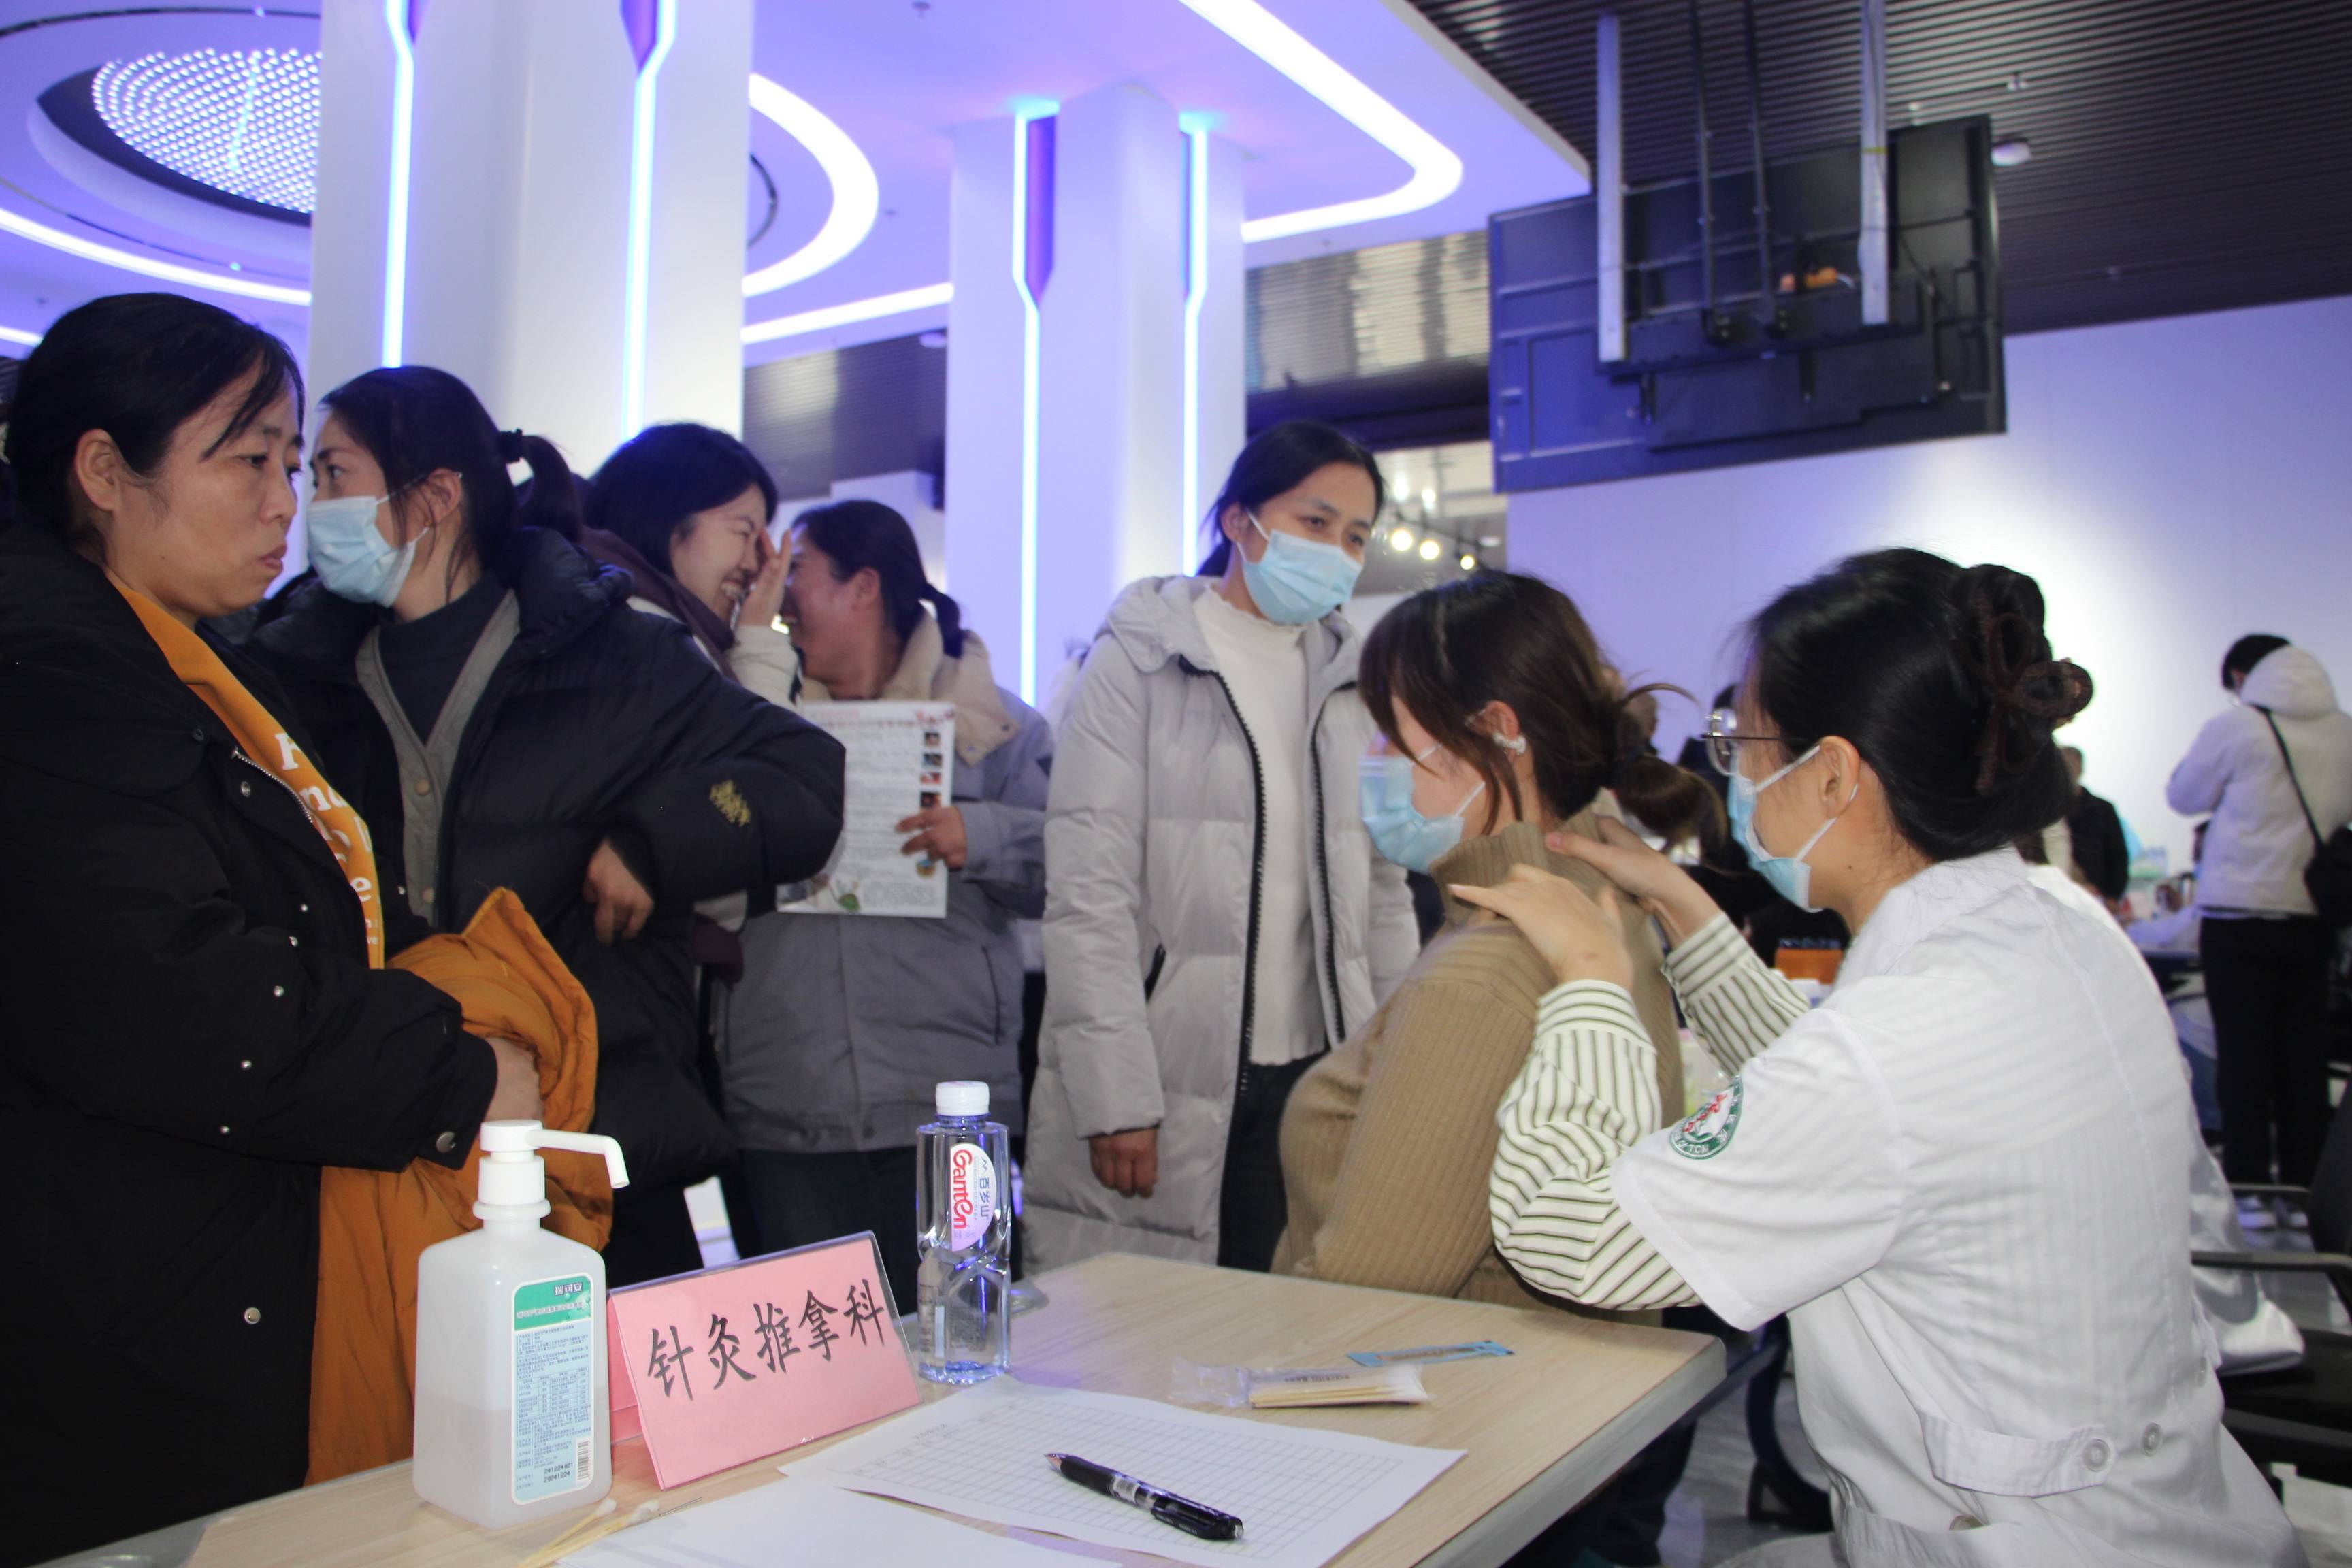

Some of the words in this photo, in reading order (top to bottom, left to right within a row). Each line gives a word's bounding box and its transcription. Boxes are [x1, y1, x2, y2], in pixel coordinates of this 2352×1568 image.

[980, 1177, 990, 1218] 百岁山
[555, 1283, 583, 1296] 瑞可安
[647, 1279, 885, 1401] 针灸推拿科
[544, 1471, 570, 1483] 20241224
